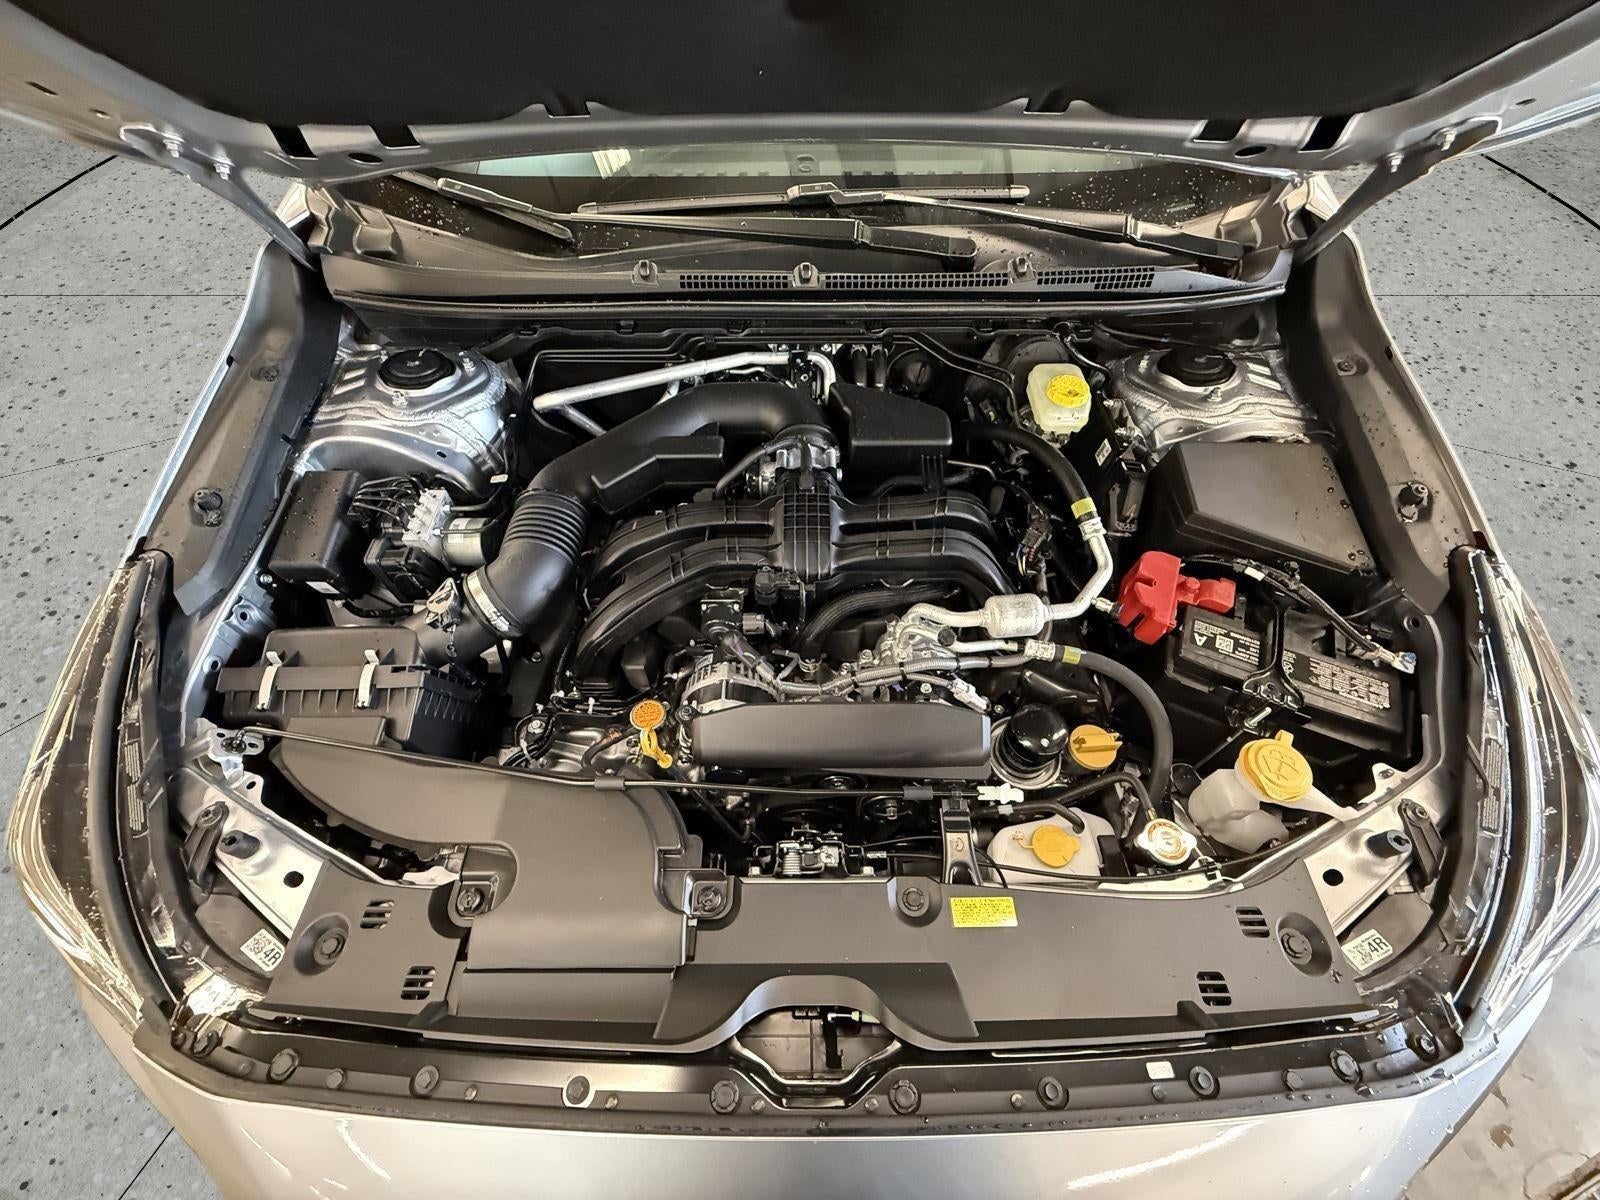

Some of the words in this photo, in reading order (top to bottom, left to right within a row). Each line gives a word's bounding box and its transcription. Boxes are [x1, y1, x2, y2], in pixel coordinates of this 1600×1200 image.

[1194, 633, 1208, 647] A
[1367, 937, 1389, 953] 4R
[263, 947, 282, 966] 4R
